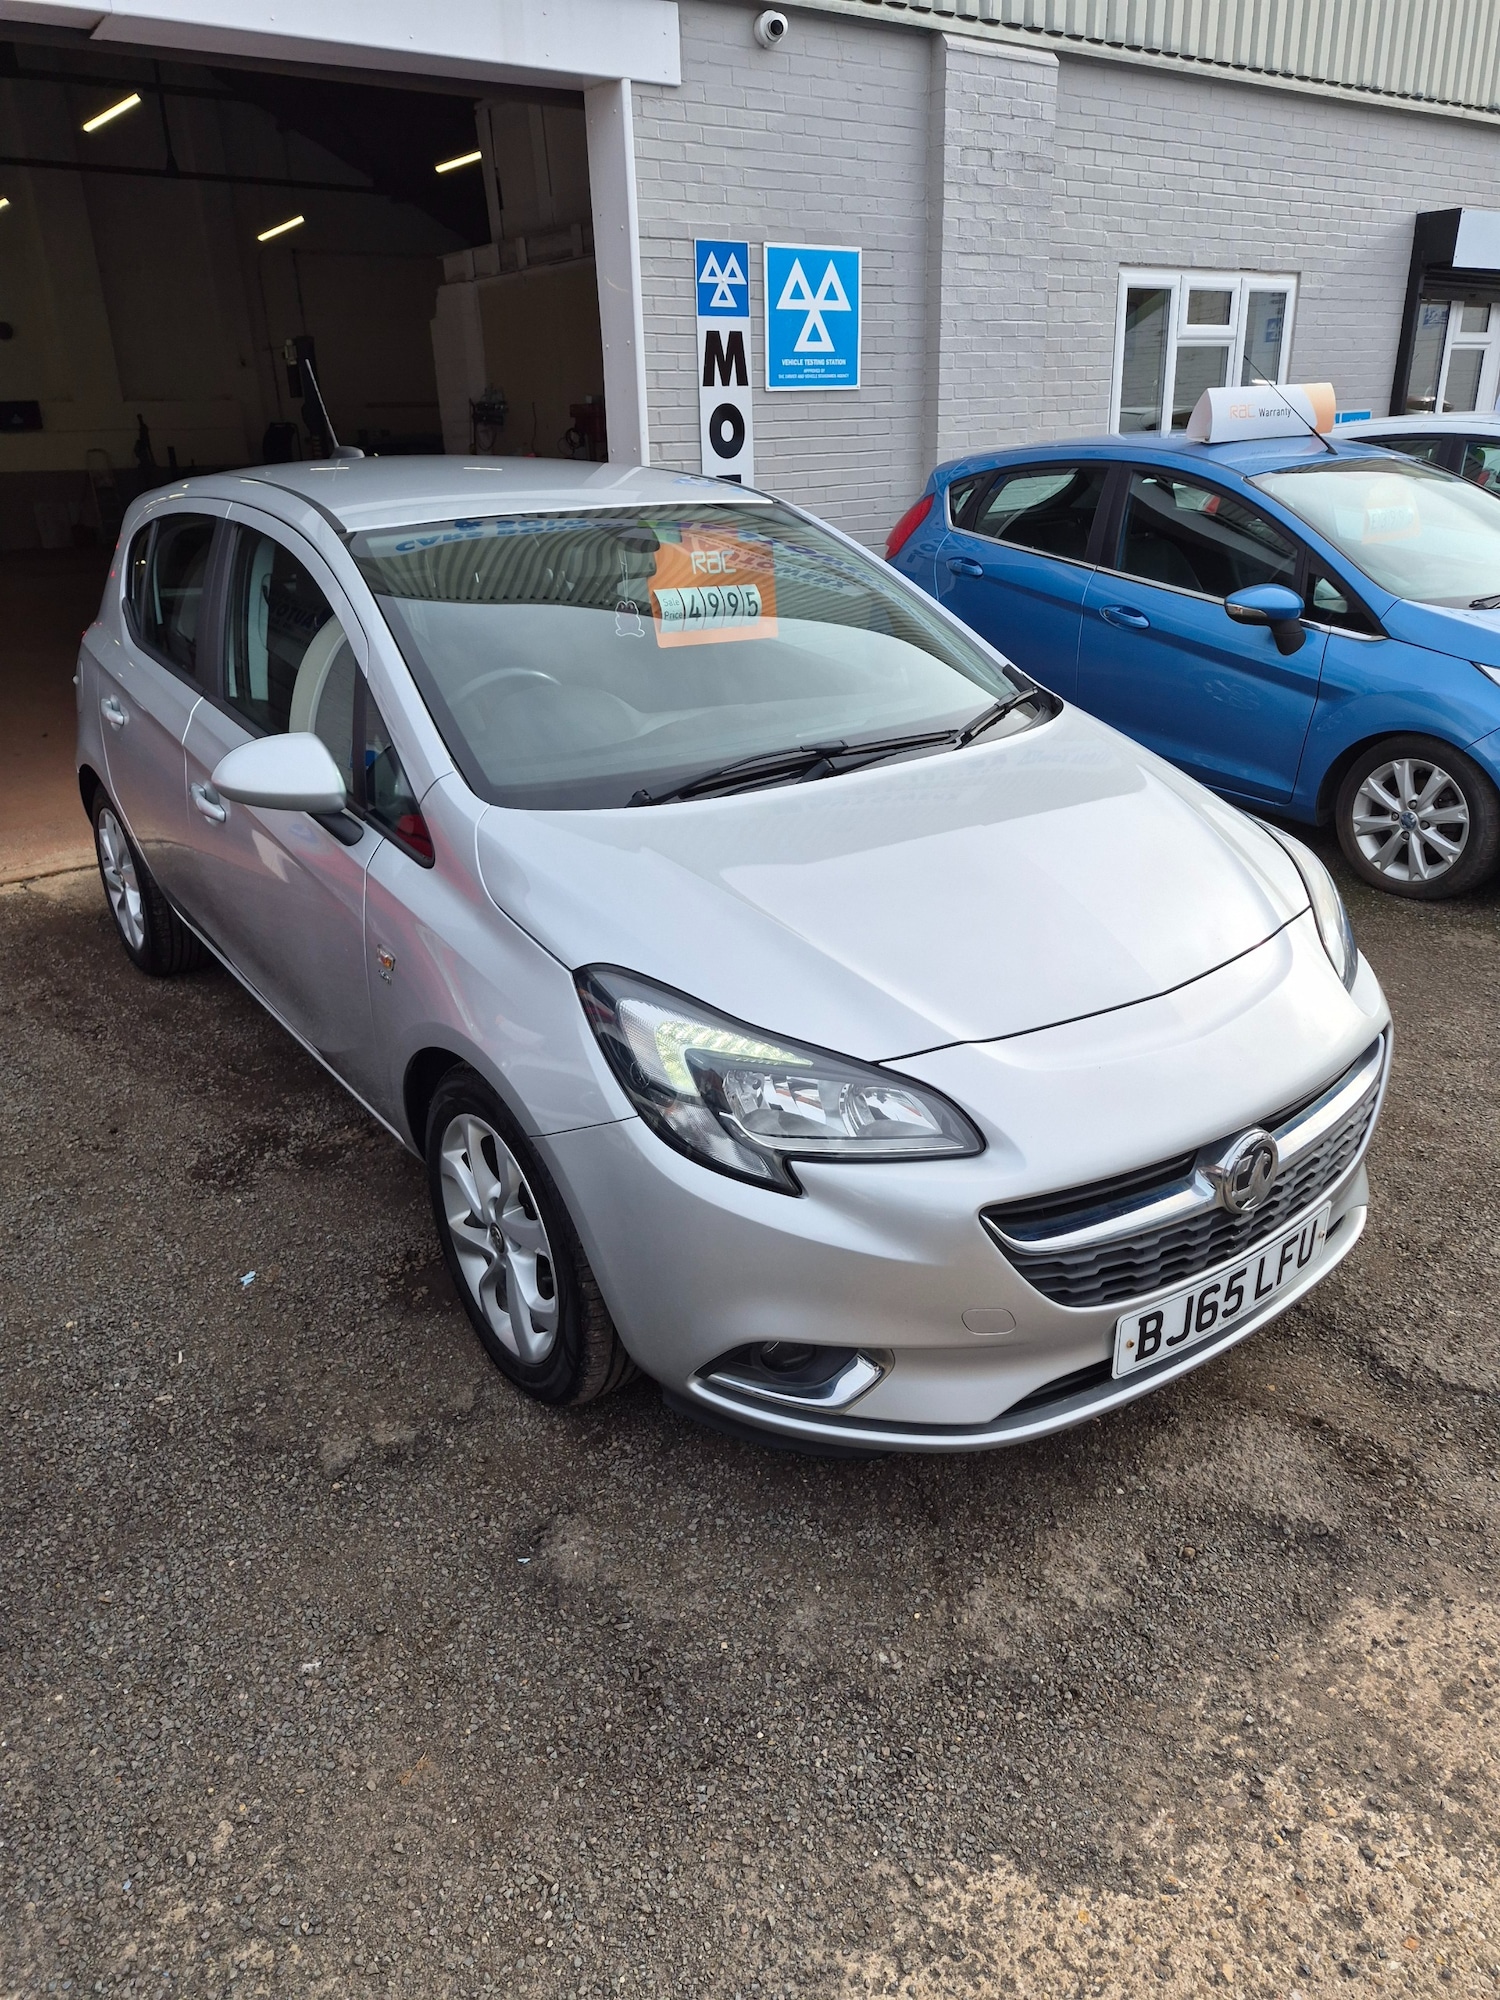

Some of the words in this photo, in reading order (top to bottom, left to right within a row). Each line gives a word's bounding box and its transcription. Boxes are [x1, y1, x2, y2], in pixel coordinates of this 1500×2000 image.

[781, 358, 804, 366] VEHICLE
[804, 358, 825, 366] TESTING
[825, 358, 847, 366] STATION
[702, 330, 749, 484] MO
[1258, 407, 1292, 418] Warranty
[663, 598, 680, 607] Sale
[688, 591, 759, 622] 4995
[664, 610, 683, 620] Price
[1134, 1267, 1247, 1362] BJ65
[1254, 1219, 1318, 1301] LFU
